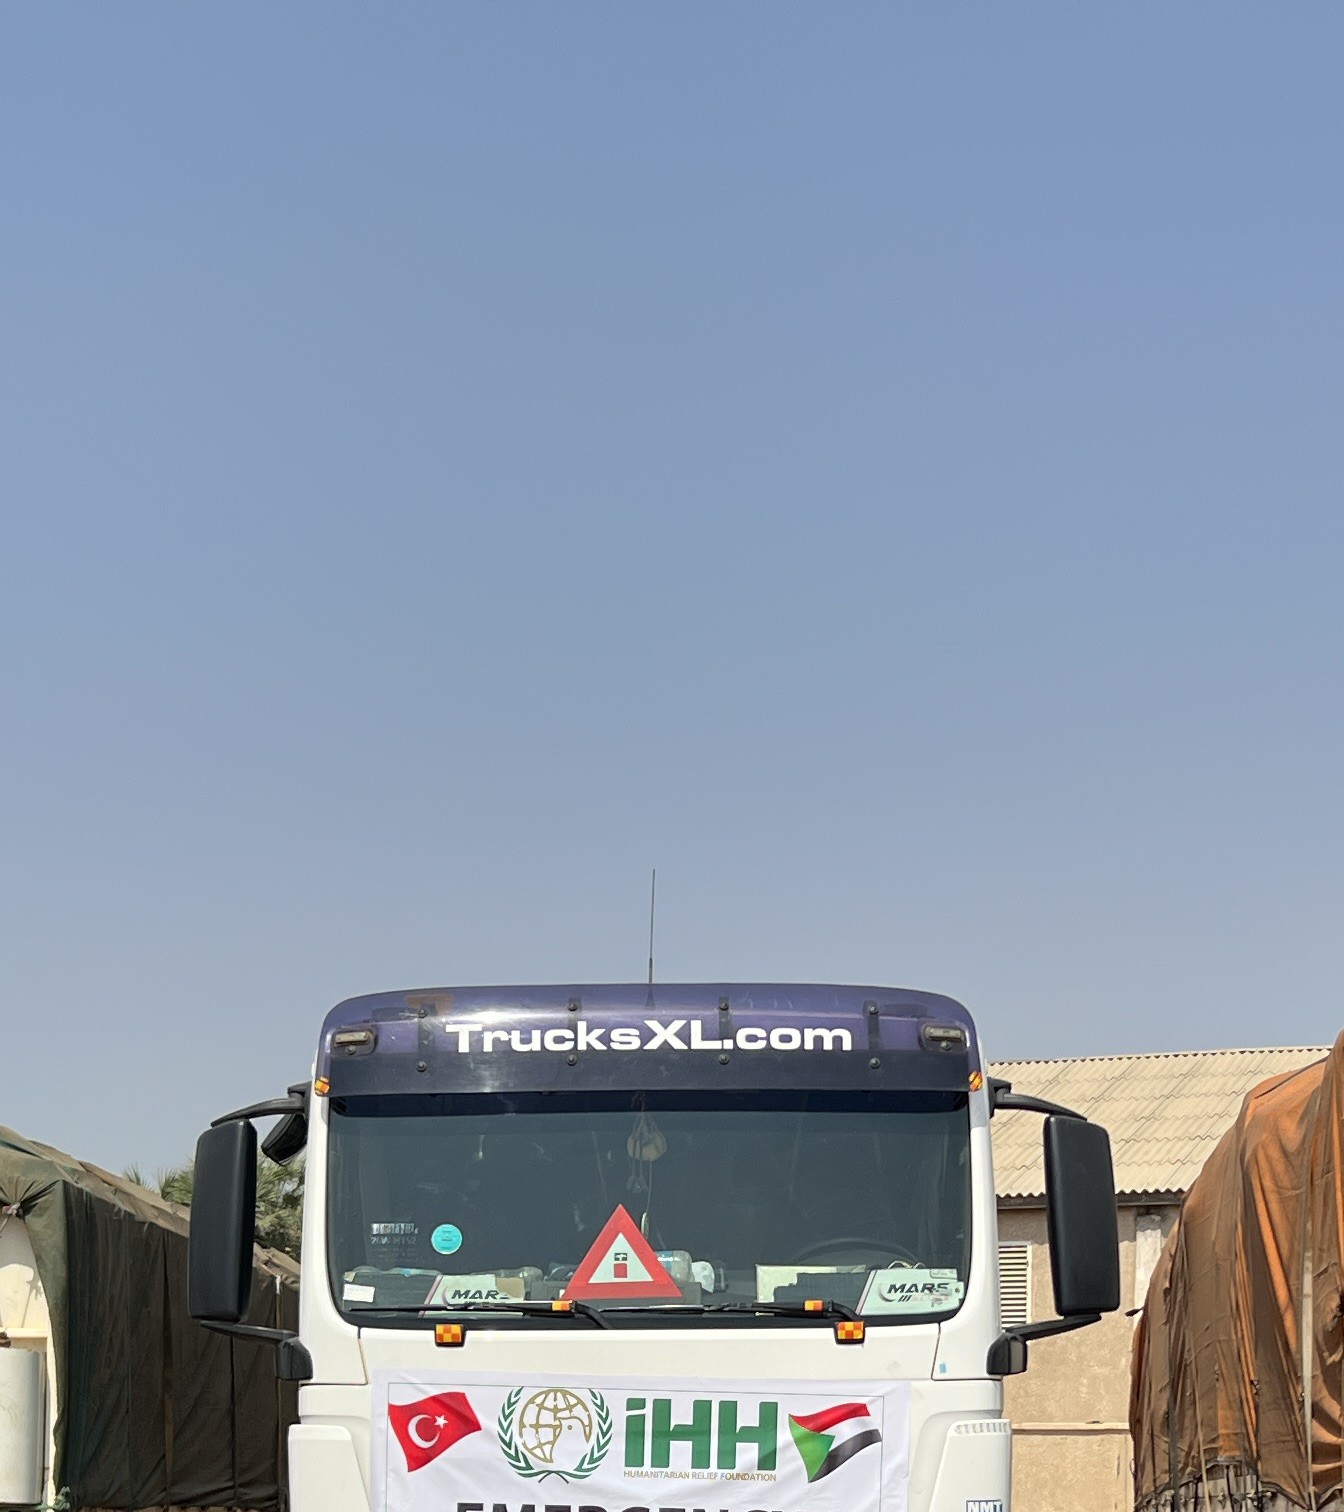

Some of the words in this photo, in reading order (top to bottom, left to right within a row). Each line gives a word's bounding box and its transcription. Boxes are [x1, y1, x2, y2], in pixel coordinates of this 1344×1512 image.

[445, 1019, 853, 1053] TrucksXL.com
[624, 1470, 690, 1480] HUMANITARIAN
[692, 1471, 718, 1480] RELIEF
[720, 1472, 777, 1482] FOUNDATION
